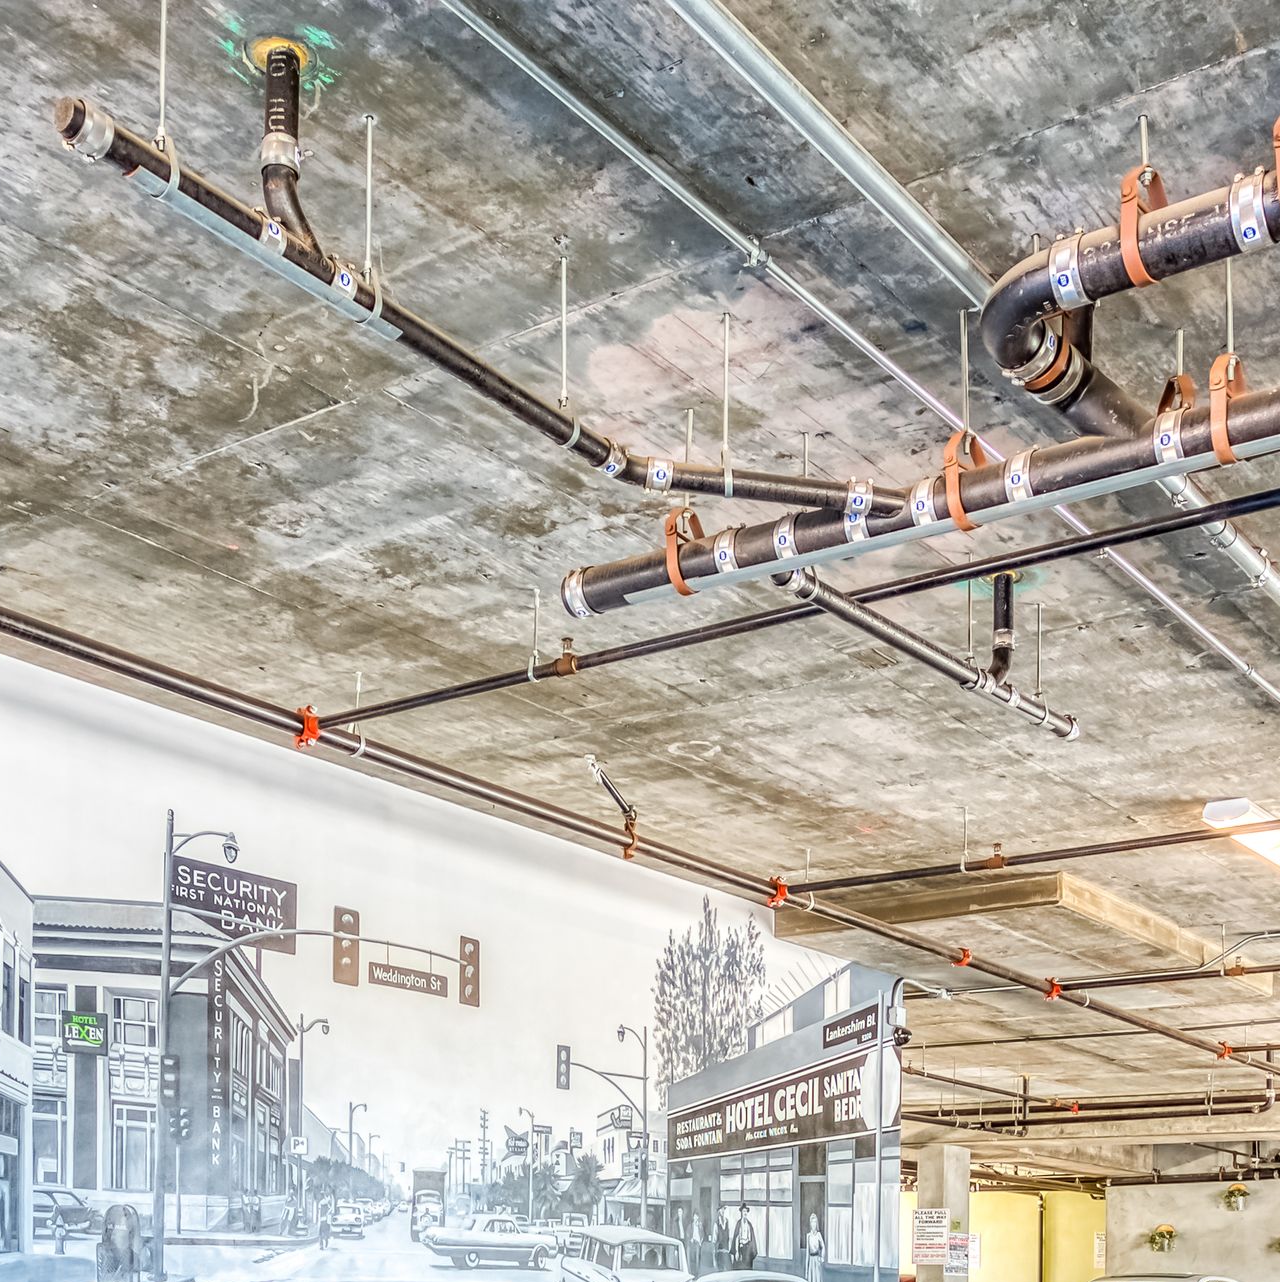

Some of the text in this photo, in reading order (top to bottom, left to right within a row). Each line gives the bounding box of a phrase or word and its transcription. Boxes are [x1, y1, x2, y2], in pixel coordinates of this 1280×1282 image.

[177, 865, 287, 906] SECURITY
[213, 893, 283, 919] NATIONAL
[372, 965, 442, 991] Weddington St
[72, 1015, 97, 1025] HOTEL
[213, 960, 223, 1085] SECURITY
[826, 1018, 866, 1042] Lankershim
[64, 1022, 104, 1045] LEXEN
[725, 1077, 824, 1134] HOTEL CECIL
[211, 1105, 222, 1165] BANK
[675, 1129, 723, 1151] SODA FOUNTAIN
